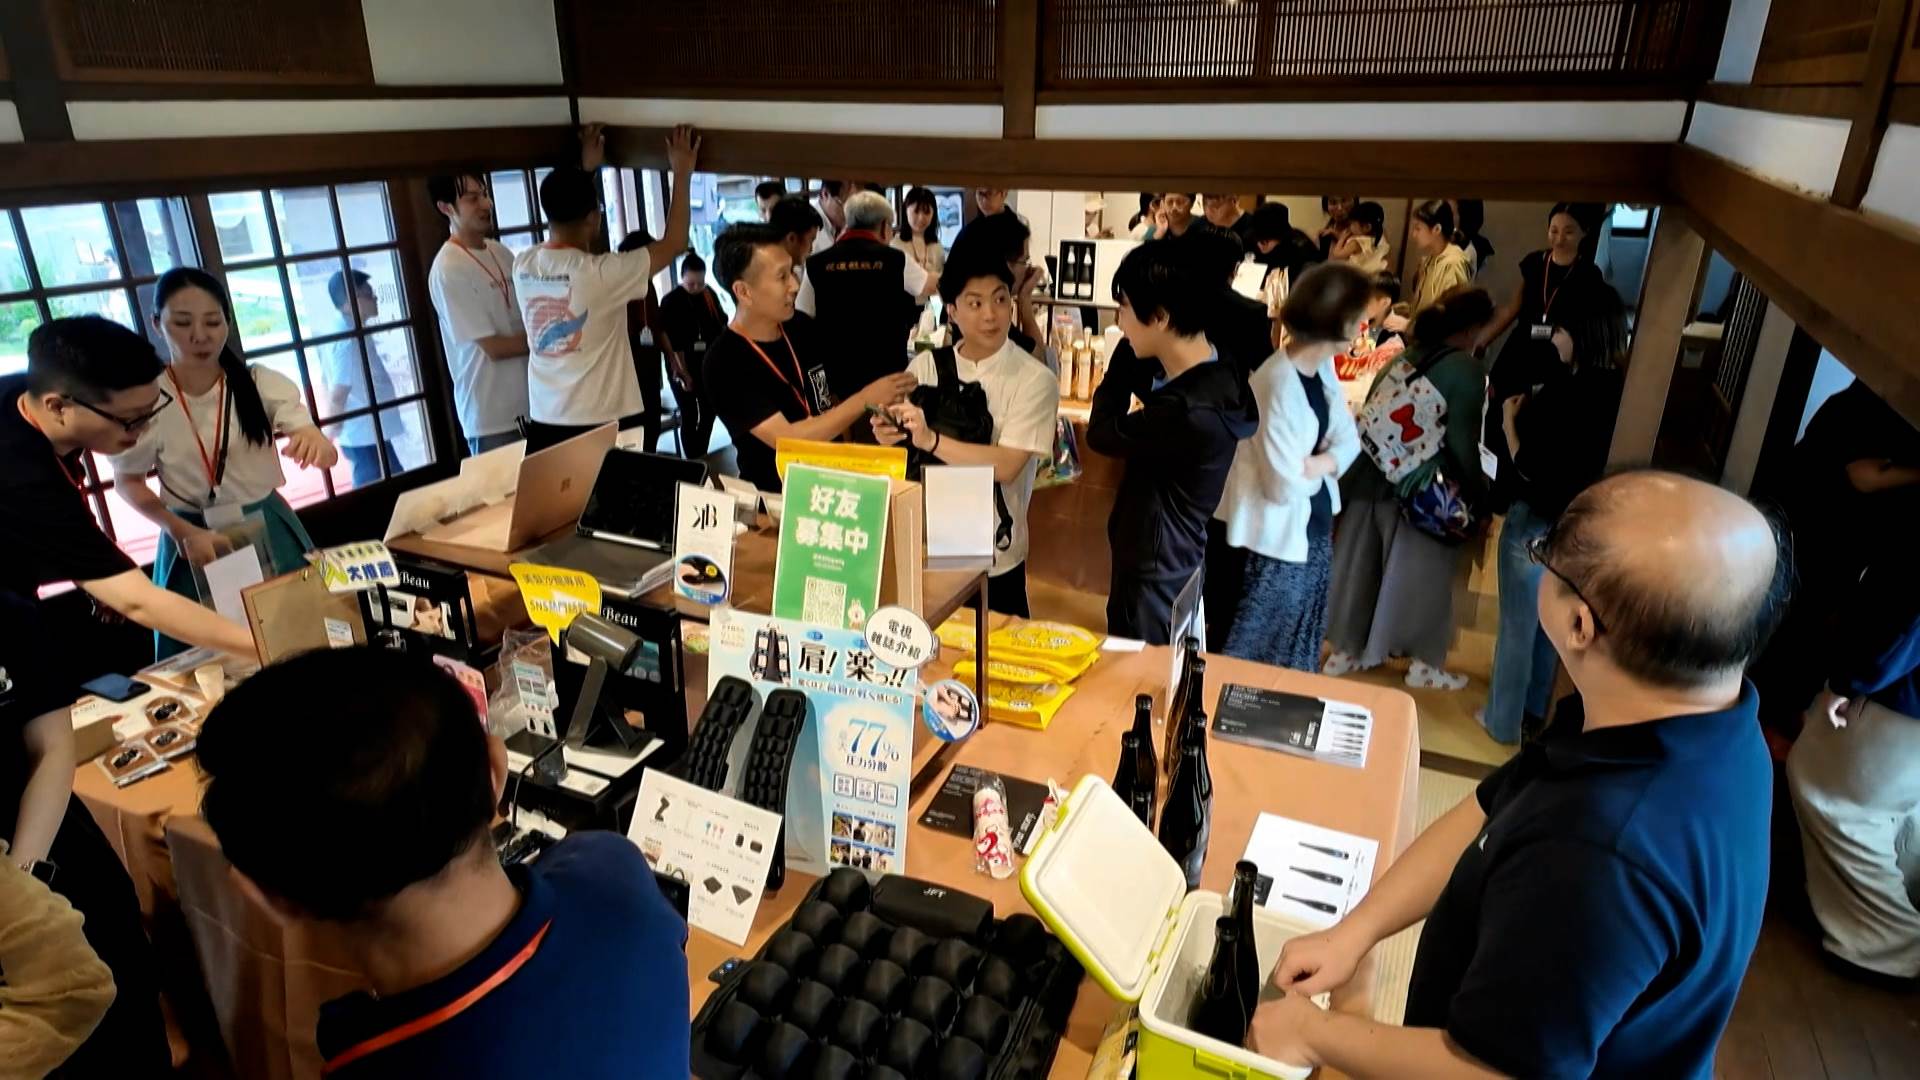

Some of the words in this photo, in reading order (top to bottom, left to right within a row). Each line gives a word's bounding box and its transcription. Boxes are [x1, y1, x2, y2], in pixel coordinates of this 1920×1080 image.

[809, 484, 862, 520] 好友
[795, 516, 869, 555] 募集中
[871, 632, 922, 660] 雜誌介紹
[888, 618, 913, 640] 電視
[848, 718, 900, 763] 77%
